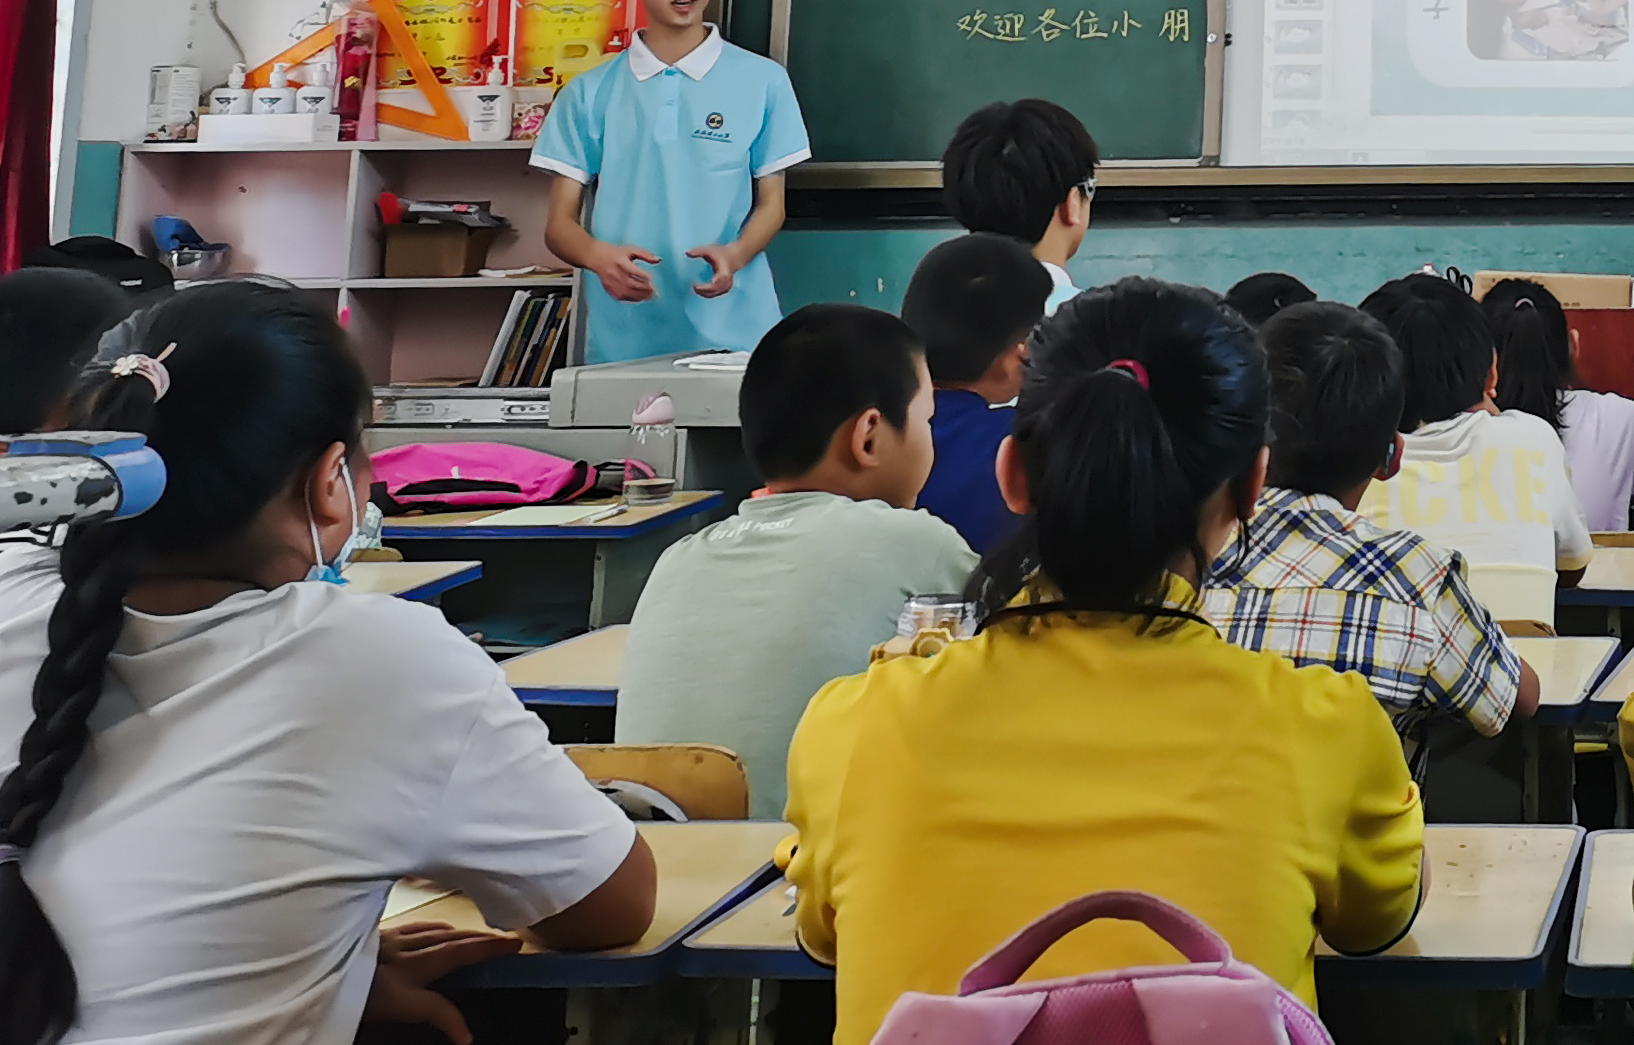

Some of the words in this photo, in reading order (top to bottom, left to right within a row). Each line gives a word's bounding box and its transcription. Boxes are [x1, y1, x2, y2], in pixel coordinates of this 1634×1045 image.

[955, 7, 1191, 43] 欢迎各位小朋
